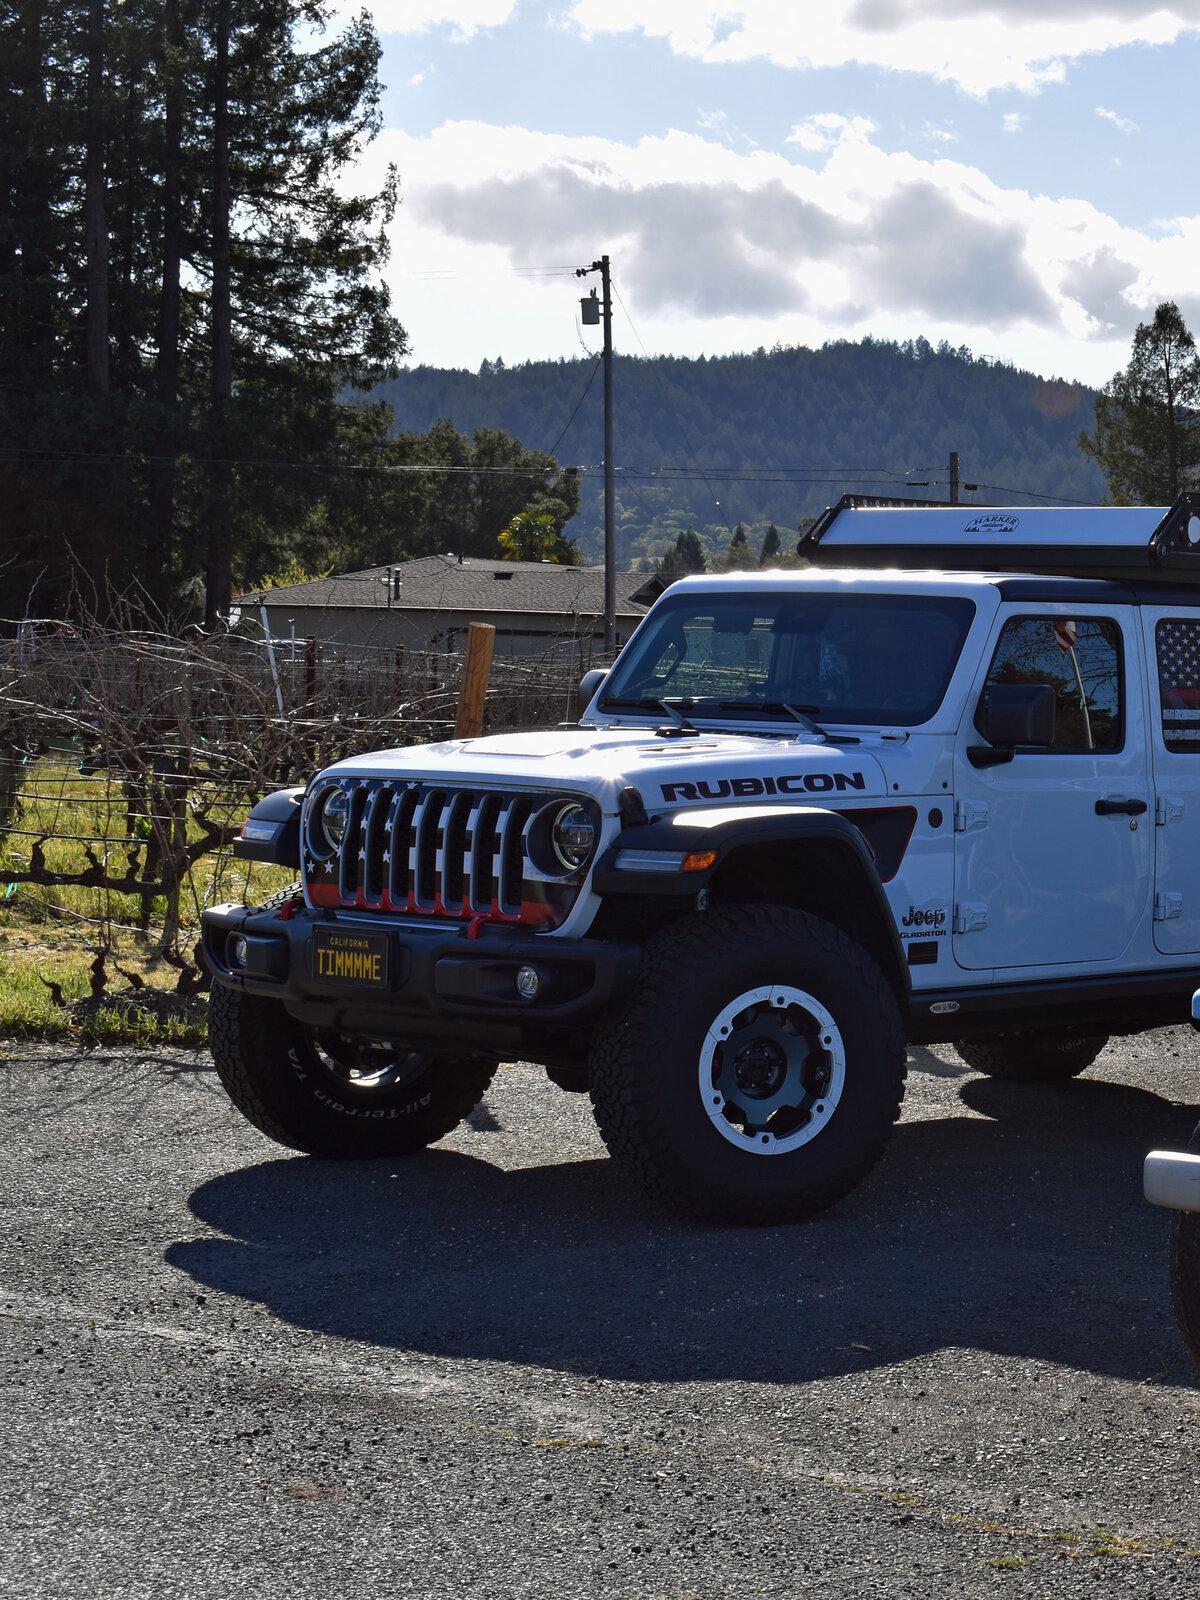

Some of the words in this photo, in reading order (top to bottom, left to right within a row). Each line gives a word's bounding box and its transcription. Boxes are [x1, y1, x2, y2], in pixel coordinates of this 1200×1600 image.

[974, 516, 1017, 526] HARKER
[660, 772, 866, 802] RUBICON
[902, 906, 945, 928] Jeep
[330, 937, 369, 948] CALIFORNIA
[899, 930, 947, 939] GLADIATOR
[317, 948, 381, 980] TIMMMME
